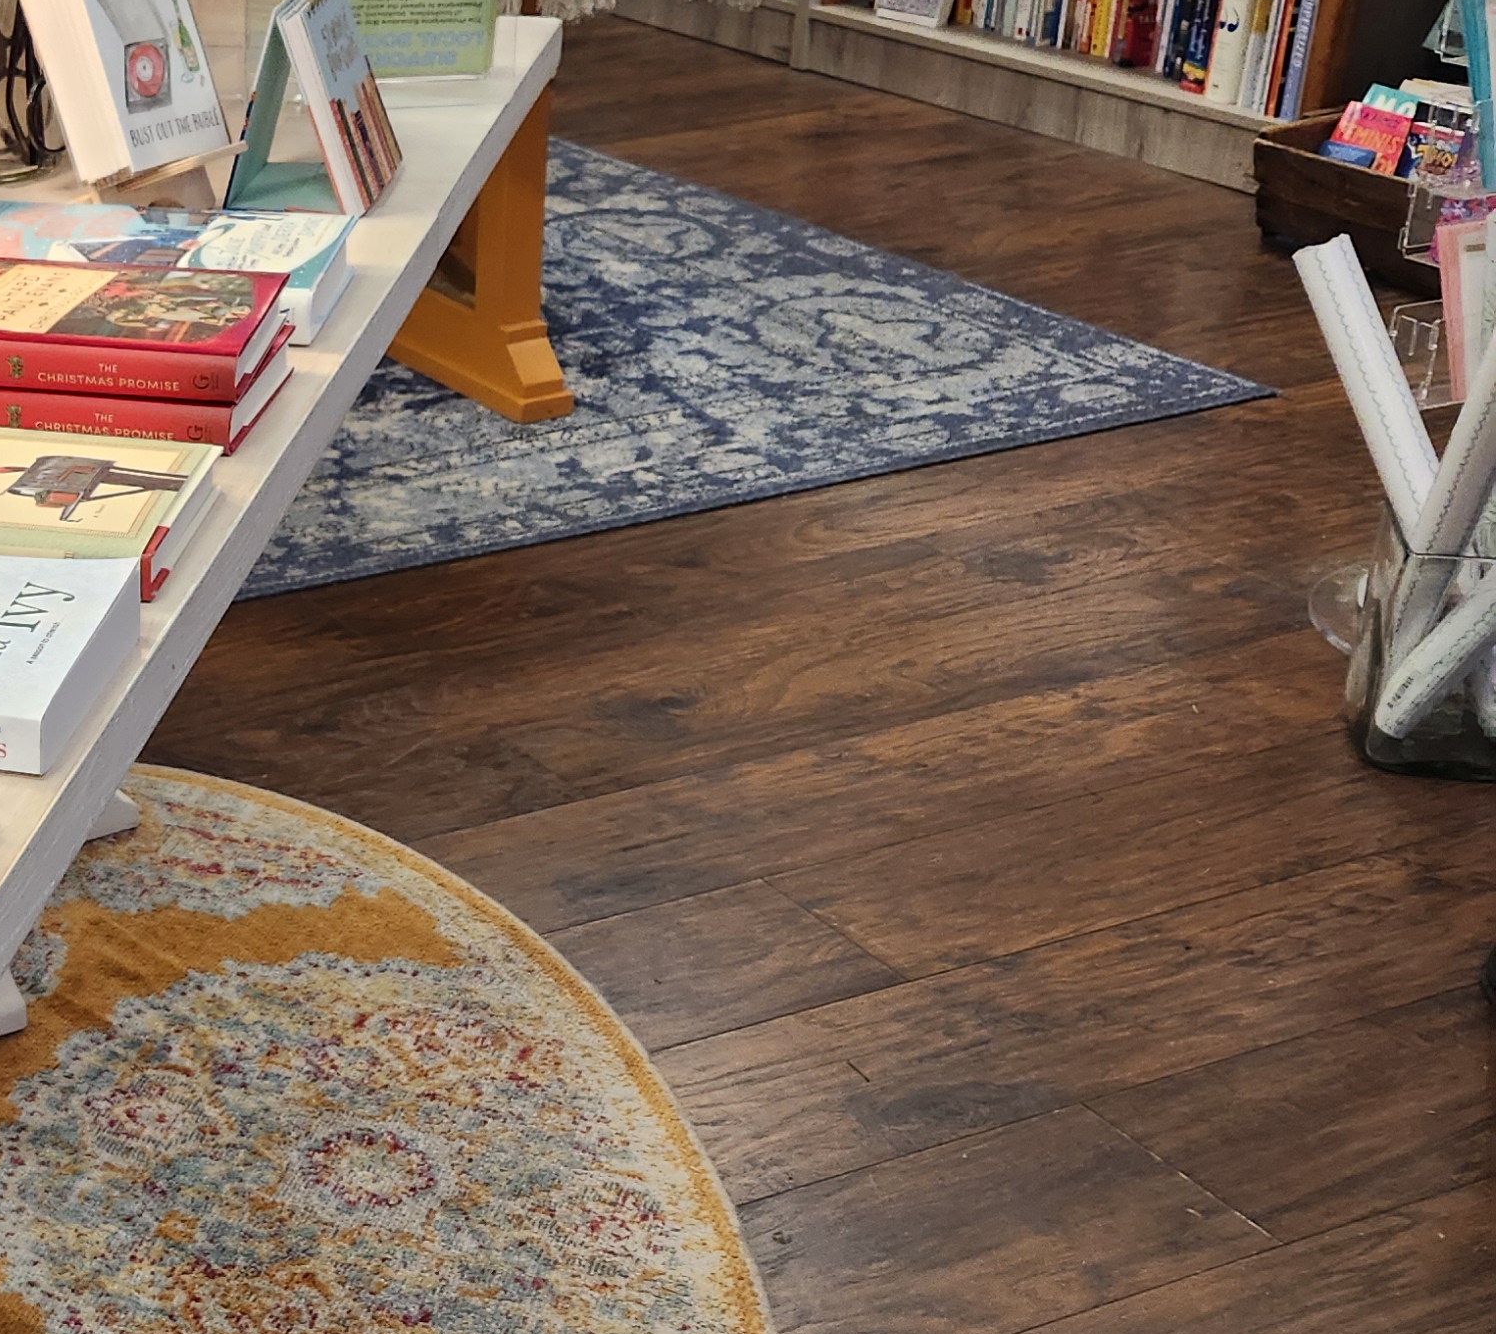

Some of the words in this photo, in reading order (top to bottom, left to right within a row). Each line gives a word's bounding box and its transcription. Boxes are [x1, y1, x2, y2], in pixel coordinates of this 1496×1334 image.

[130, 124, 153, 147] BUST
[156, 120, 176, 140] OUT
[177, 116, 192, 134] THE
[98, 363, 119, 374] THE
[37, 371, 115, 388] CHRISTMAS
[118, 376, 181, 392] PROMISE
[94, 412, 115, 424] THE
